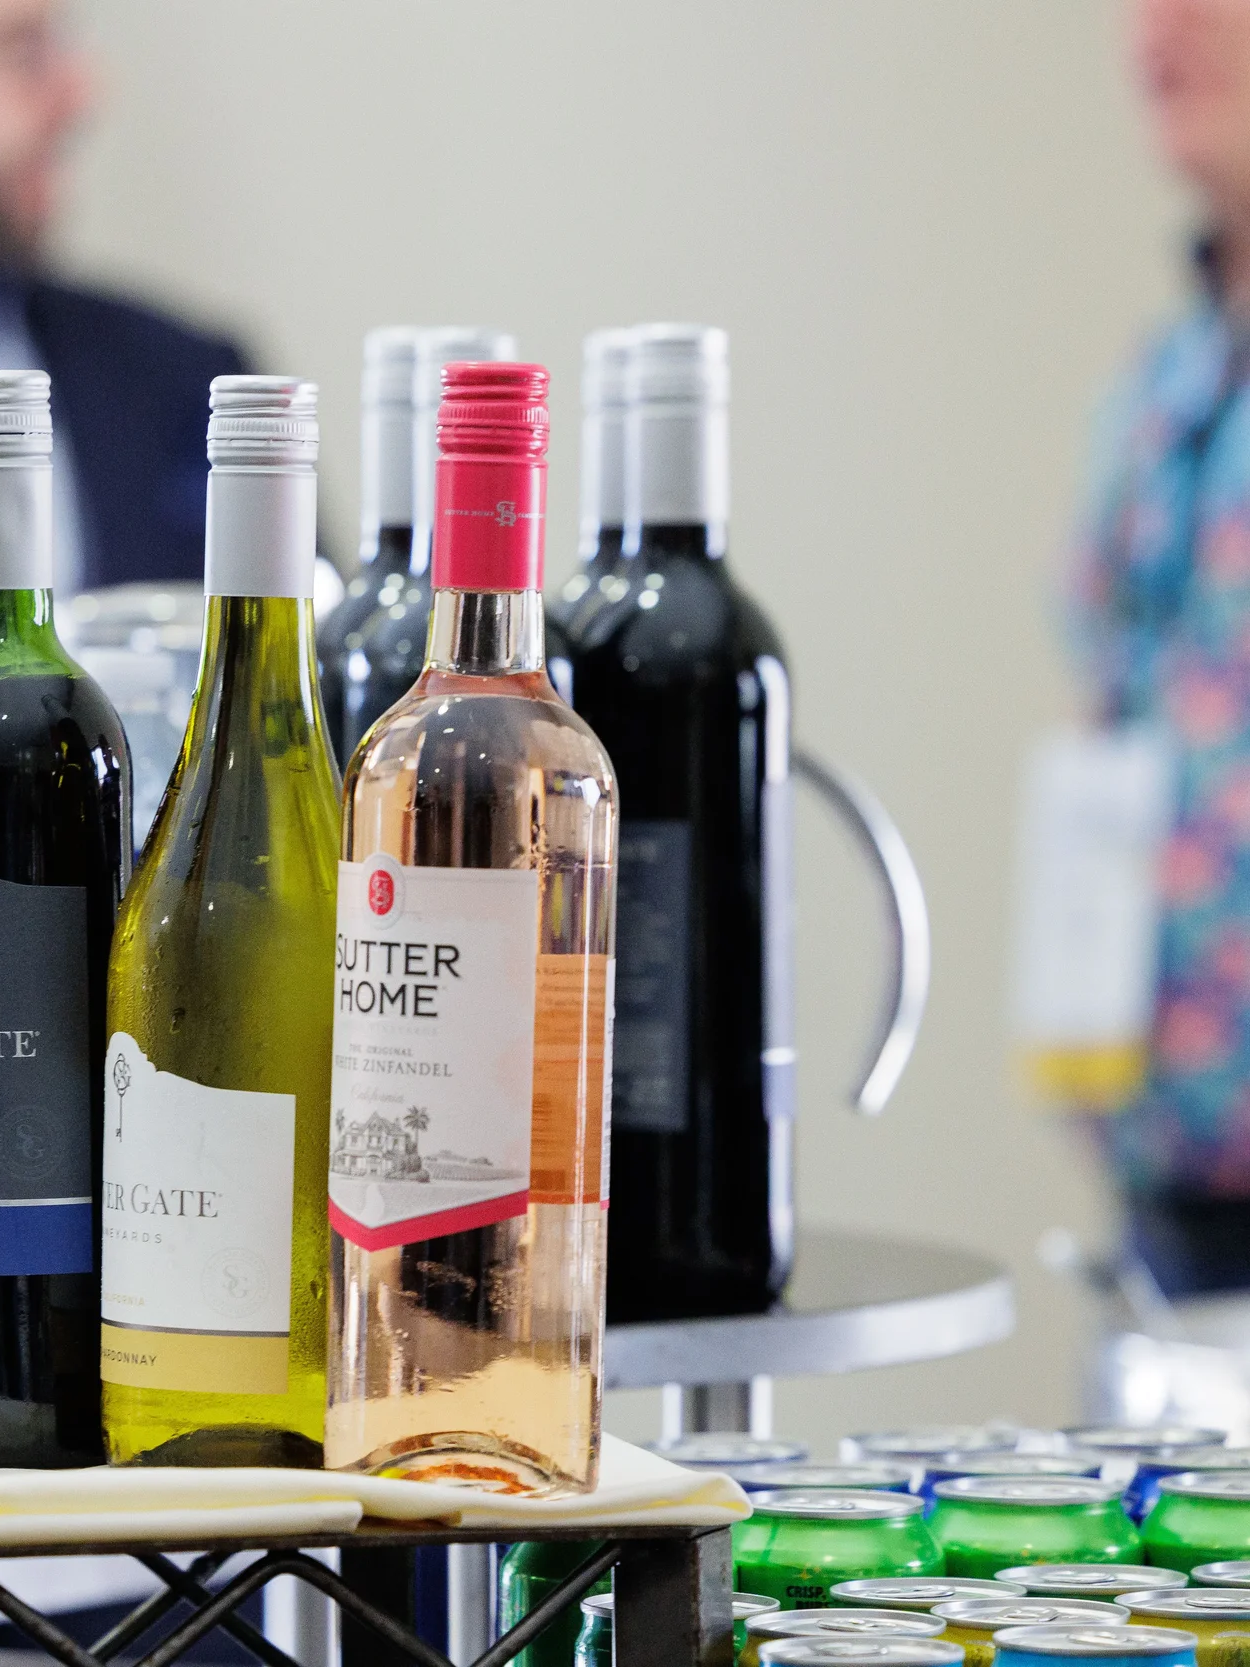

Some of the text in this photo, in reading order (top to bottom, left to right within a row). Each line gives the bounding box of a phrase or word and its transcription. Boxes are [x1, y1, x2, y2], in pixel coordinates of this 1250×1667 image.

[336, 933, 461, 978] SUTTER
[341, 978, 438, 1018] HOME
[363, 1059, 453, 1078] ZINFANDEL
[131, 1183, 219, 1218] GATE
